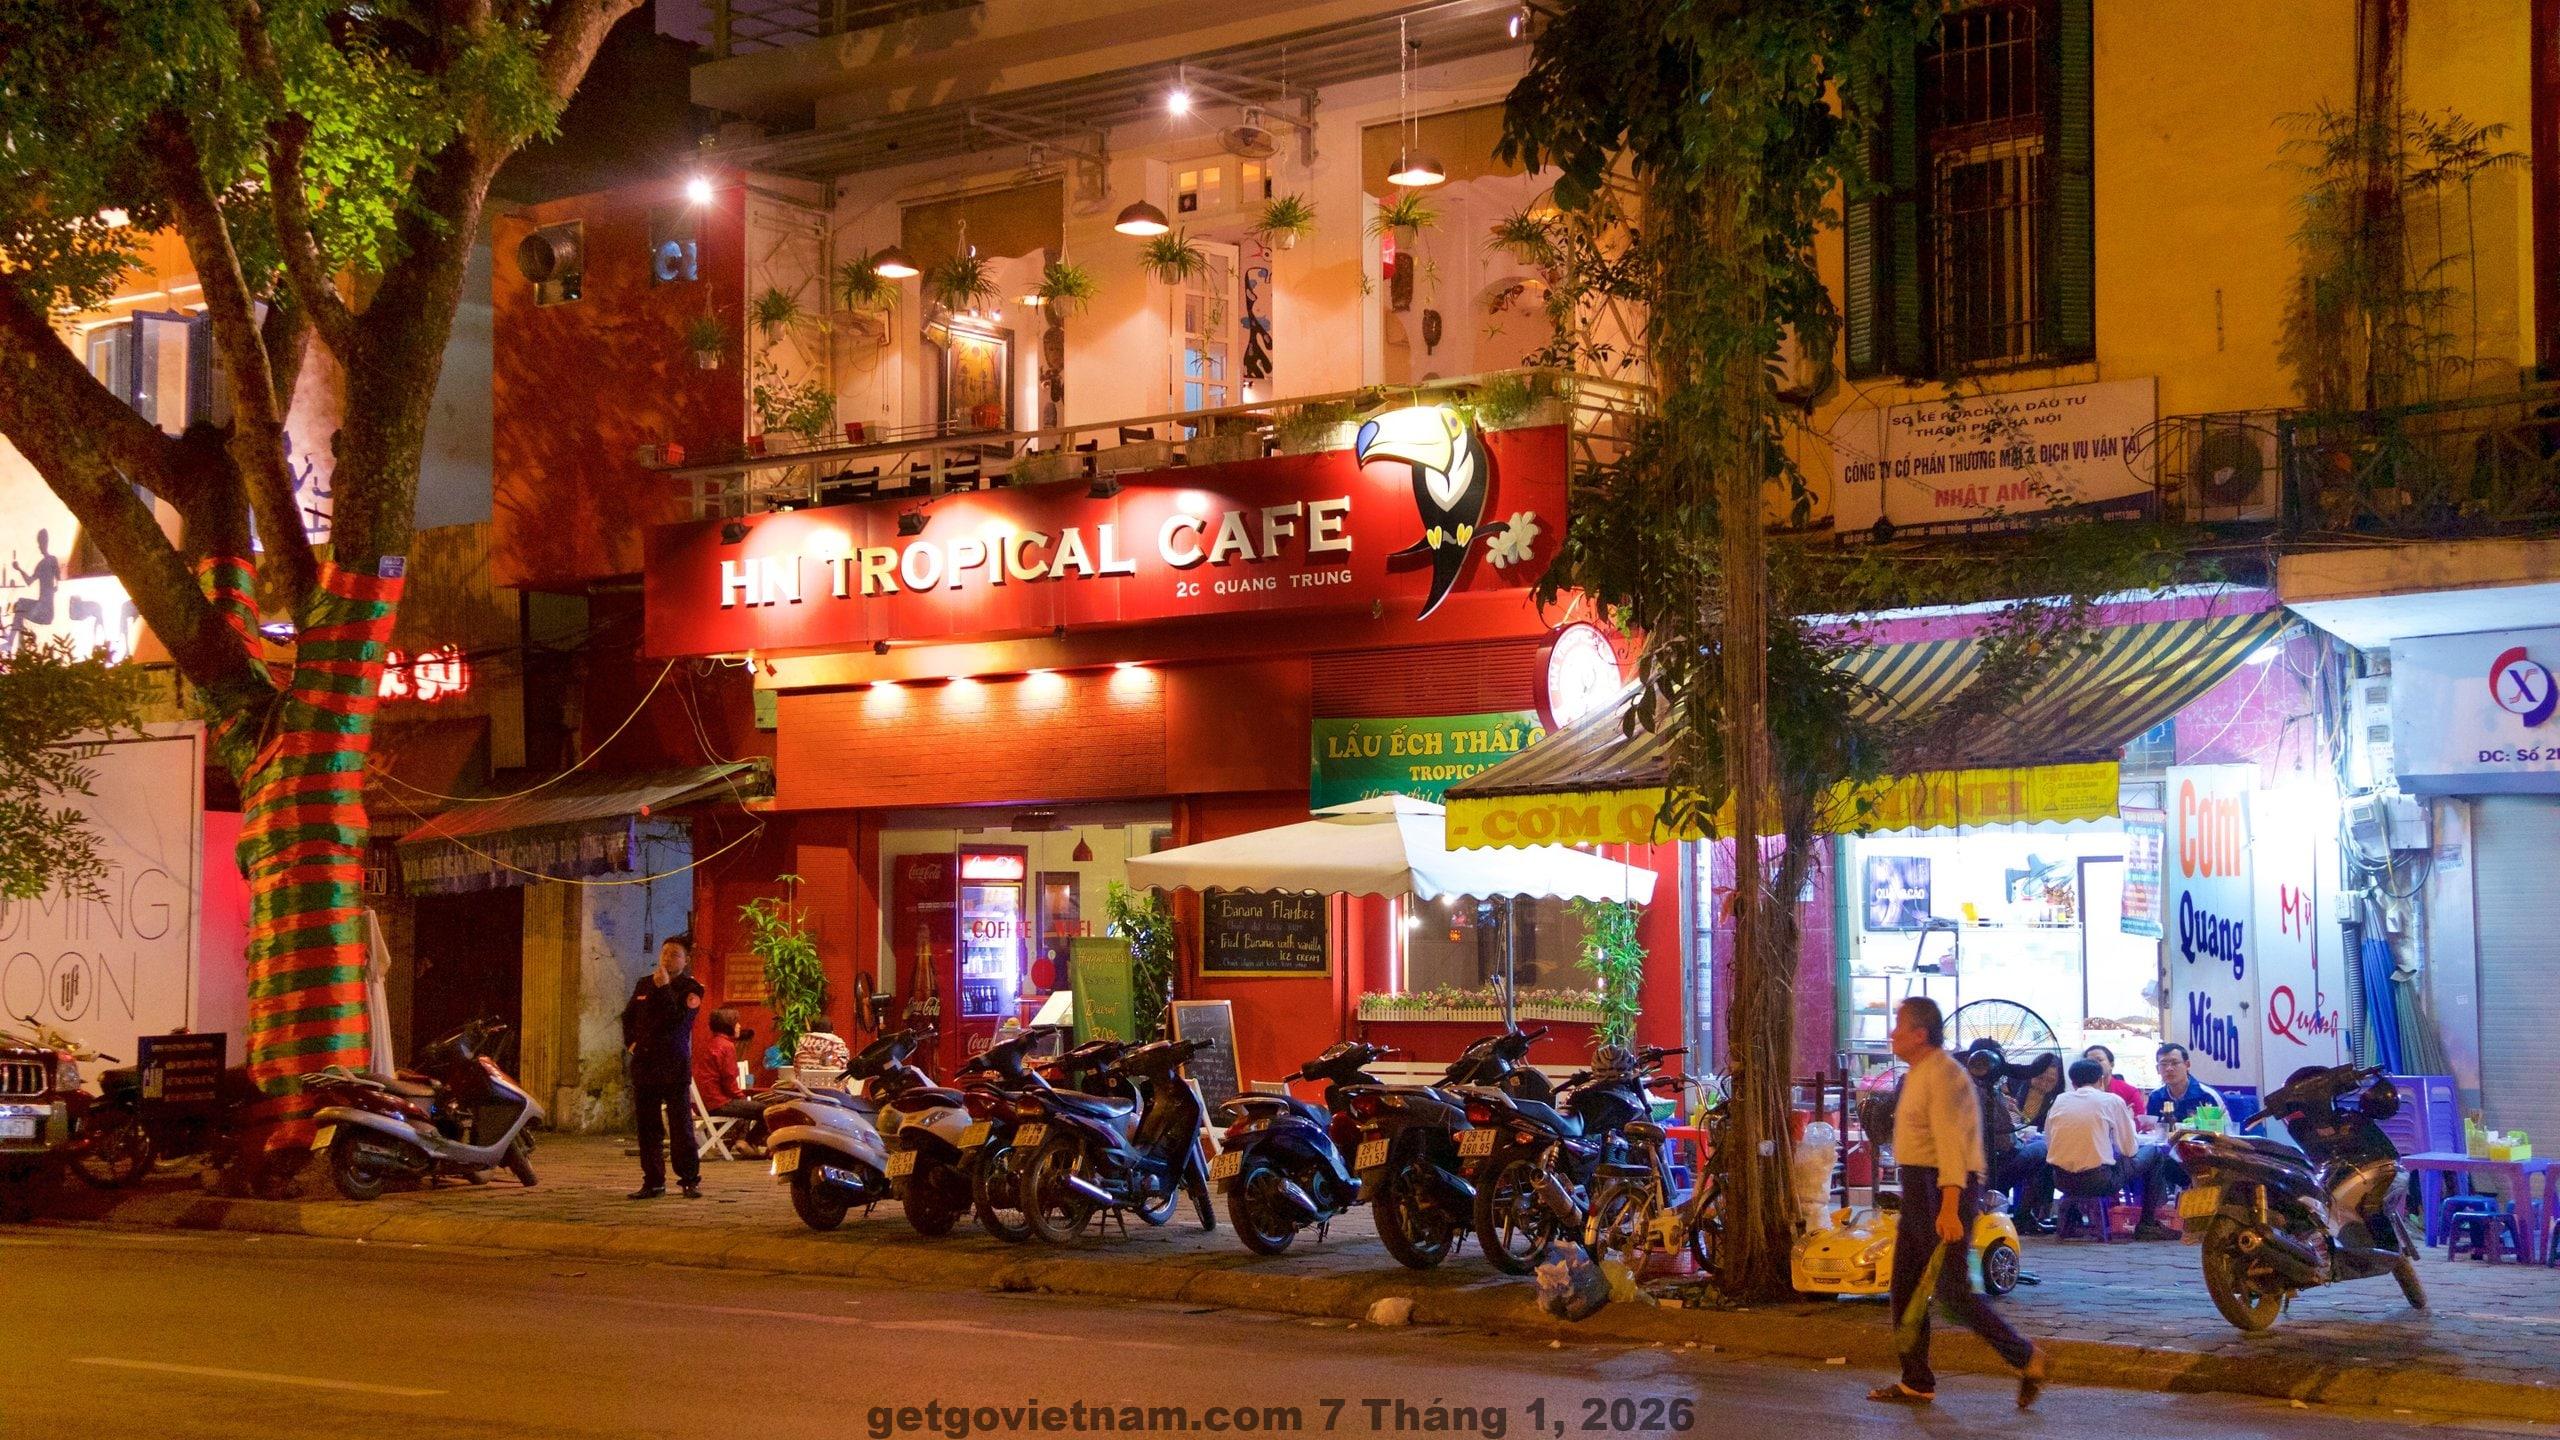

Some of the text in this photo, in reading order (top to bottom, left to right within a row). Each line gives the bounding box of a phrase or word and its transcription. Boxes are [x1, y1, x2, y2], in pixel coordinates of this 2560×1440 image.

[1844, 460, 1875, 484] CÔNG
[2040, 442, 2069, 467] DỊCH
[2073, 440, 2088, 463] VỤ
[2092, 434, 2117, 462] VẬN
[1935, 483, 1990, 508] NHẬT
[721, 495, 1353, 607] HN TROPICAL CAFE
[1214, 576, 1277, 595] QUANG
[1289, 569, 1352, 588] TRUNG
[1327, 722, 1383, 759] LẨU
[1389, 724, 1443, 757] ẾCH
[1451, 723, 1526, 754] THÁI
[2478, 750, 2511, 763] ĐC:
[2516, 746, 2540, 762] Số
[1482, 803, 1602, 841] CƠM
[2179, 778, 2241, 879] Cơm
[1220, 899, 1263, 918] Banana
[1220, 931, 1240, 949] Fried
[2180, 890, 2245, 981] Quang
[2188, 991, 2241, 1069] Minh
